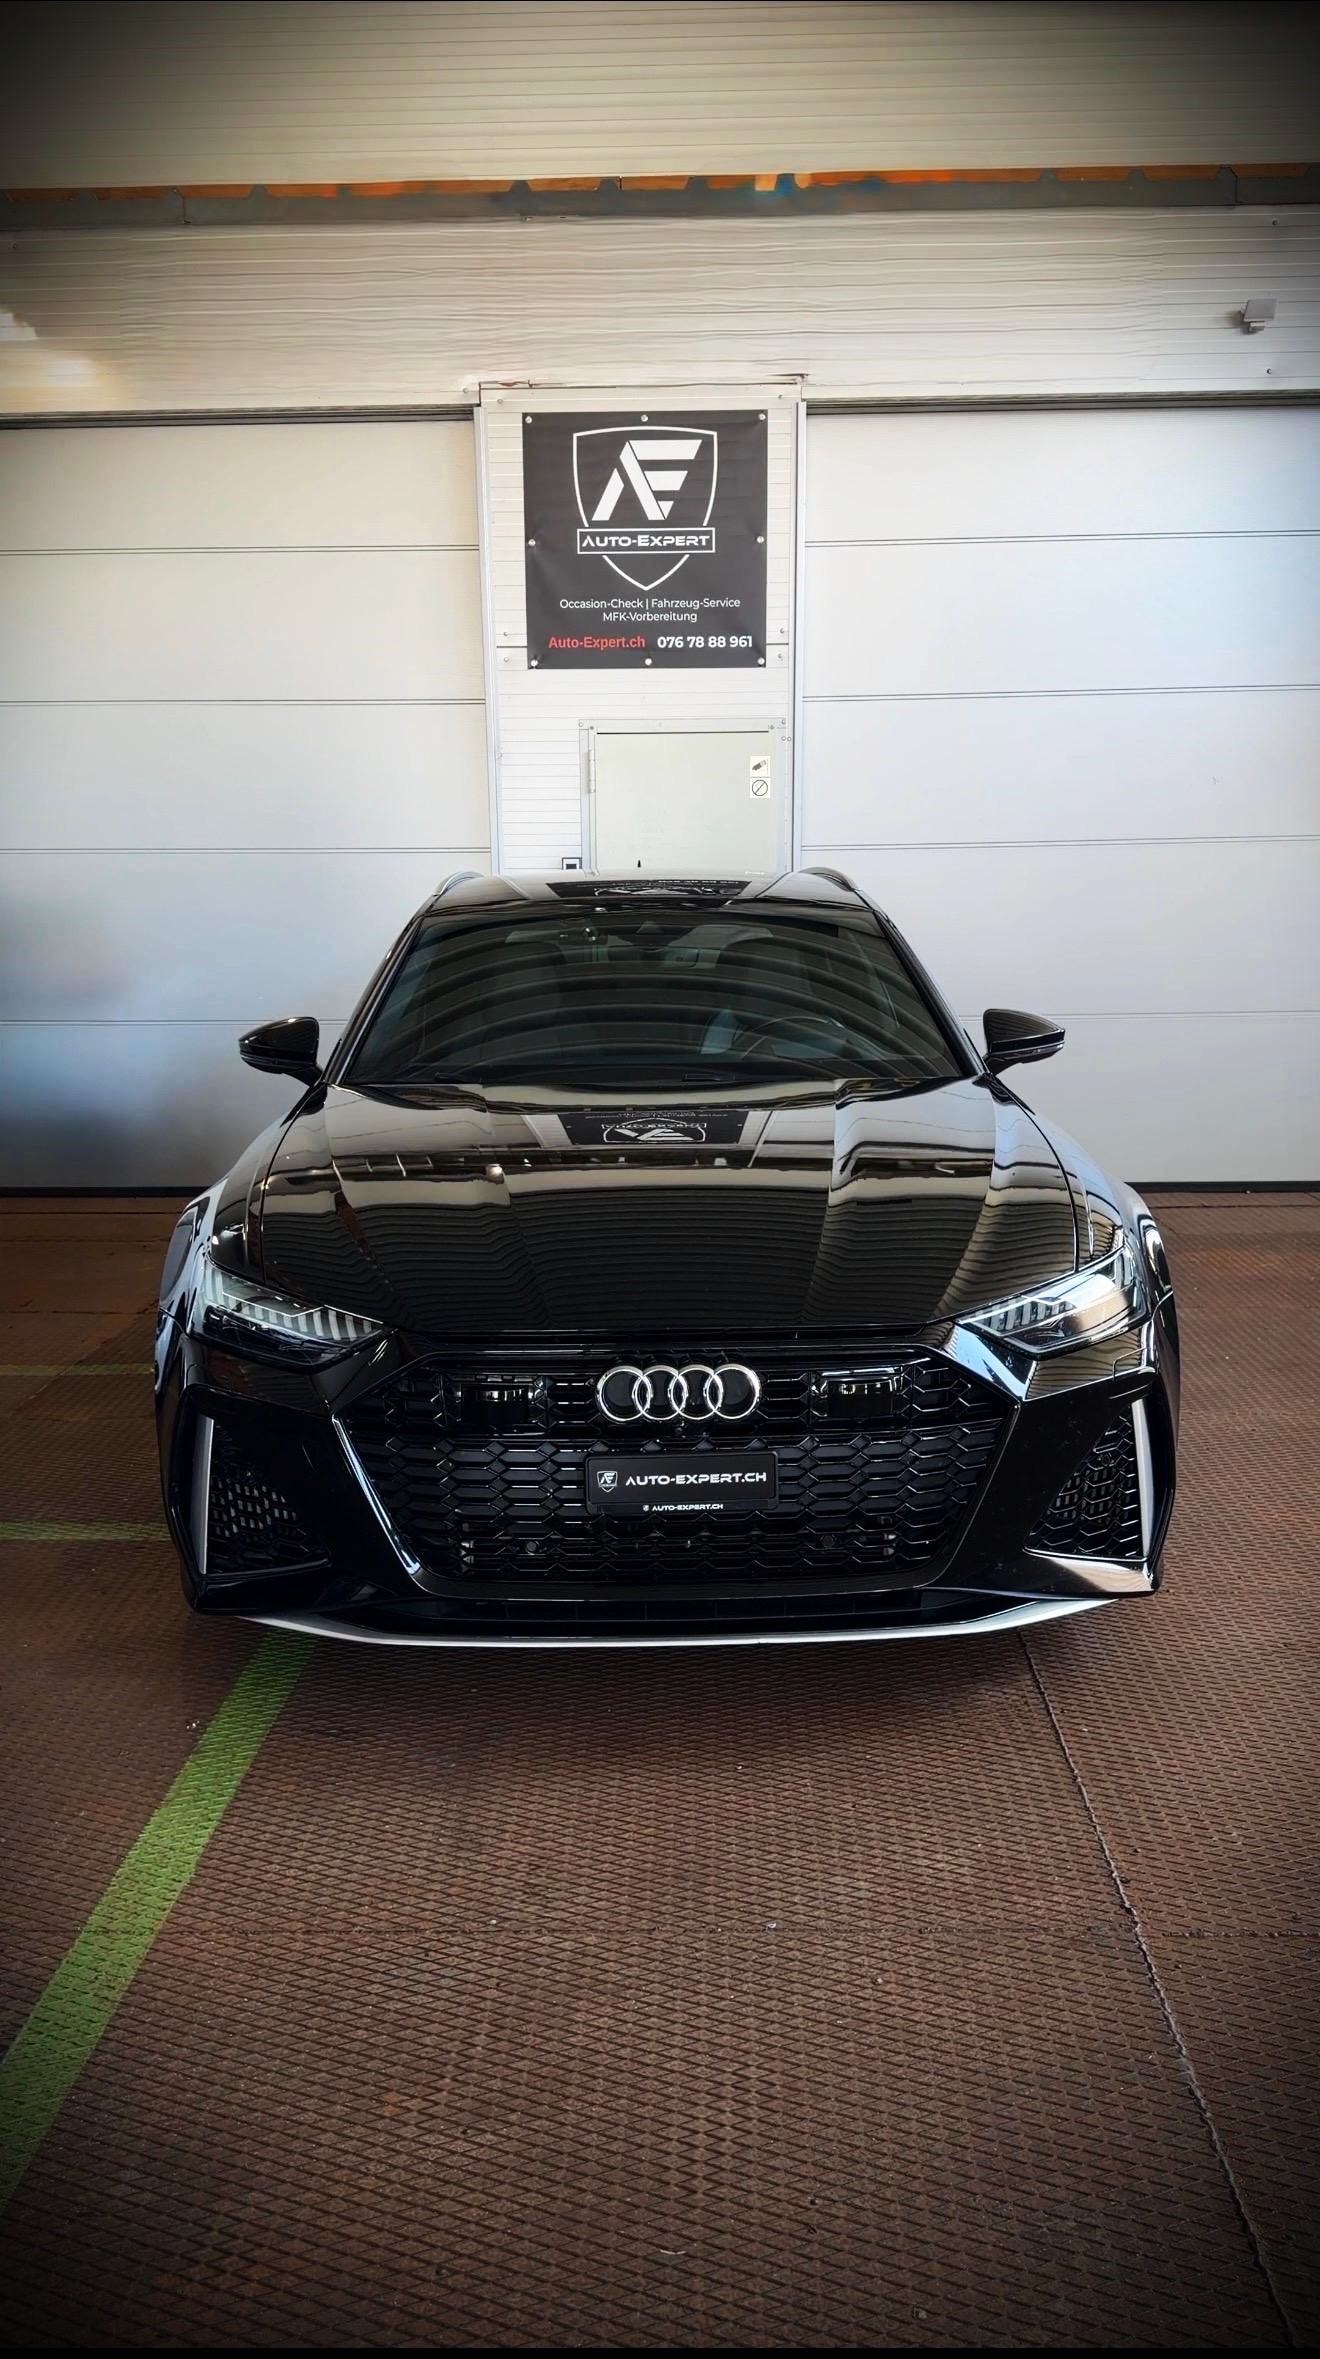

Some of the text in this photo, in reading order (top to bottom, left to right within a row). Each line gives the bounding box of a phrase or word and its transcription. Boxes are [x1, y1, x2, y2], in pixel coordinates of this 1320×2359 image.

[559, 598, 644, 609] Occasion-Check
[651, 597, 741, 609] Fahrzeug-Service
[602, 611, 698, 623] MFK-Vorbereitung
[548, 635, 753, 651] Auto-Expert.ch 076 78 88 961
[625, 1472, 767, 1486] AUTO-EXPERT.CH
[651, 1503, 724, 1512] AUTO-EXPERT.CH
